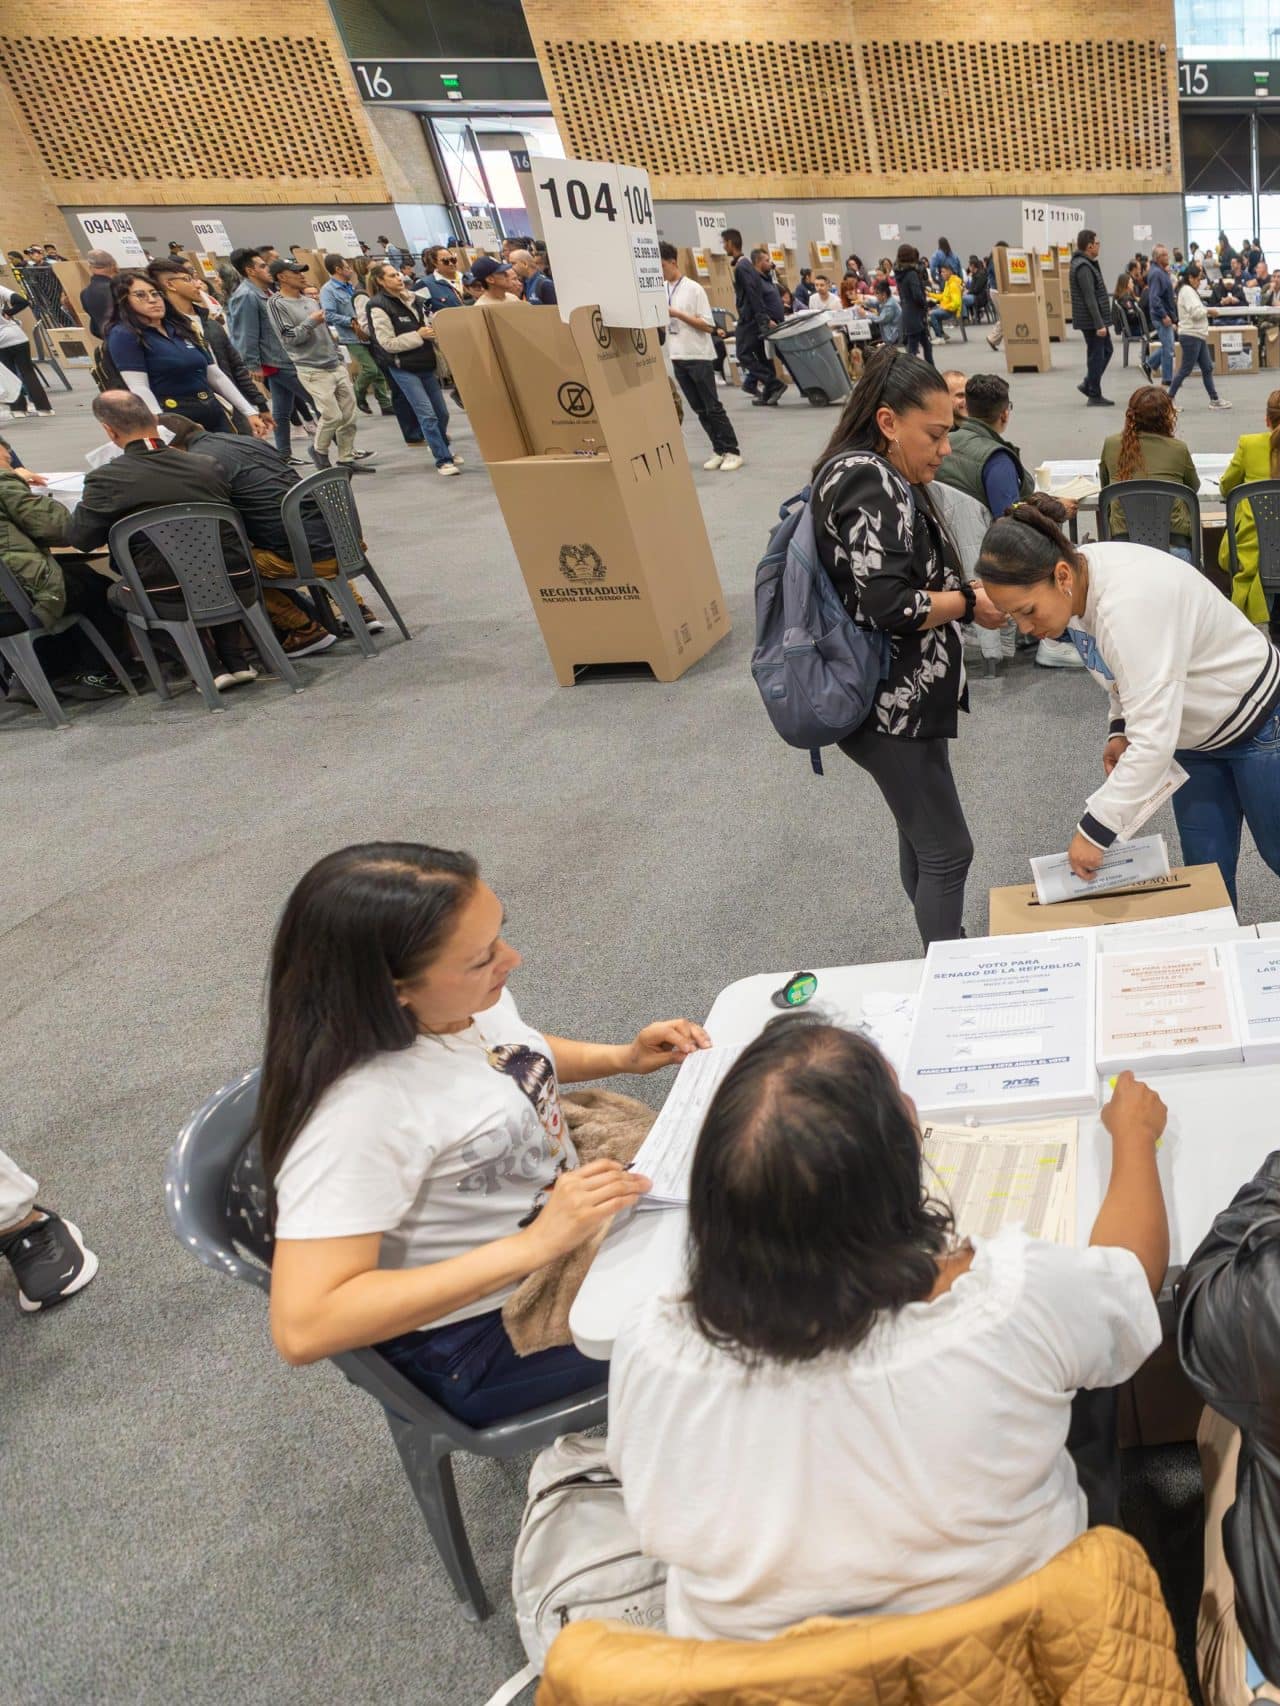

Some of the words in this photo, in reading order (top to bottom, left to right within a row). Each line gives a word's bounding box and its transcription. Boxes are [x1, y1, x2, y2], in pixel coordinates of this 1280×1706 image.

[357, 66, 393, 98] 16
[1180, 64, 1209, 95] 15
[513, 155, 531, 168] 16
[540, 178, 618, 222] 104
[624, 185, 653, 225] 104
[775, 217, 790, 227] 101
[1024, 208, 1045, 222] 112
[1050, 210, 1065, 222] 111
[84, 219, 112, 234] 094
[112, 219, 133, 233] 094
[318, 219, 338, 233] 093
[698, 217, 716, 228] 102
[539, 584, 640, 597] REGISTRADURÍA
[978, 961, 1008, 969] VOTO
[933, 971, 980, 980] SENADO
